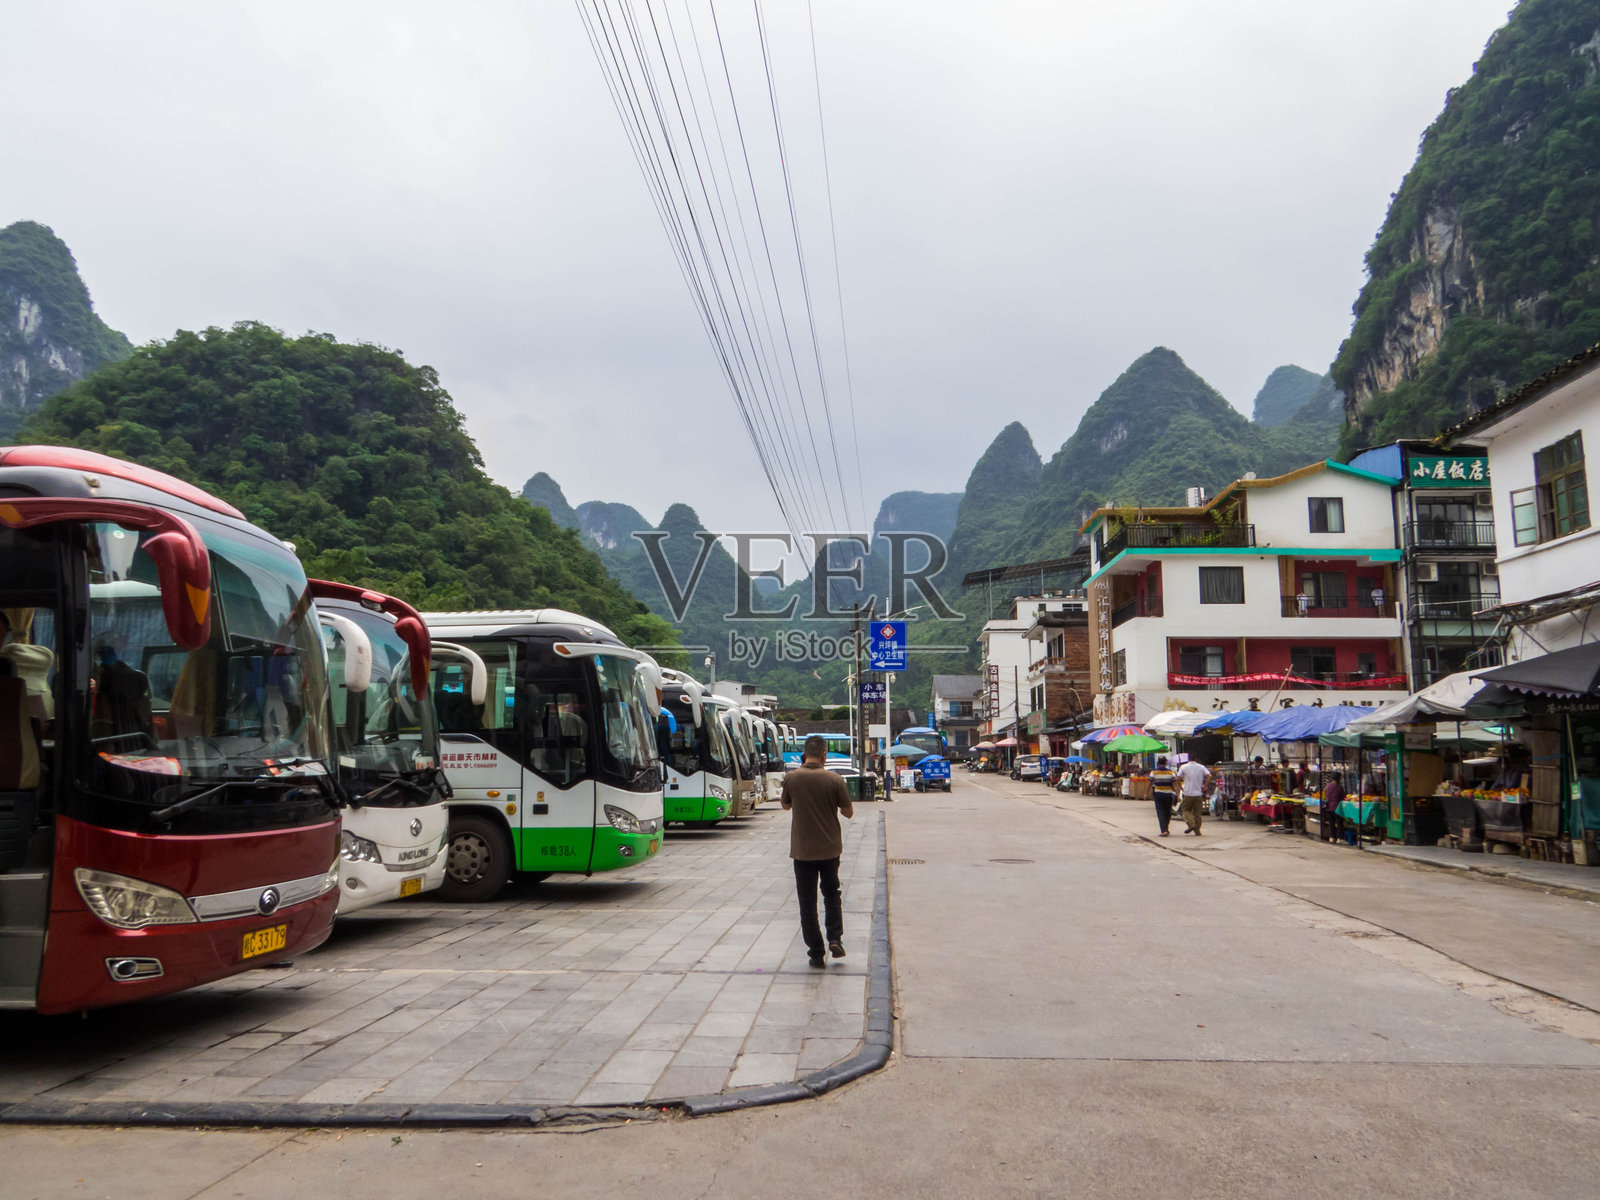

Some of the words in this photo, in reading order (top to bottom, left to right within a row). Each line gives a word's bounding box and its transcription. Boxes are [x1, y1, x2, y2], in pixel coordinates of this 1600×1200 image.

[878, 640, 898, 650] 兴坪镇
[871, 651, 904, 661] 中心卫生院
[862, 691, 887, 700] 停车场
